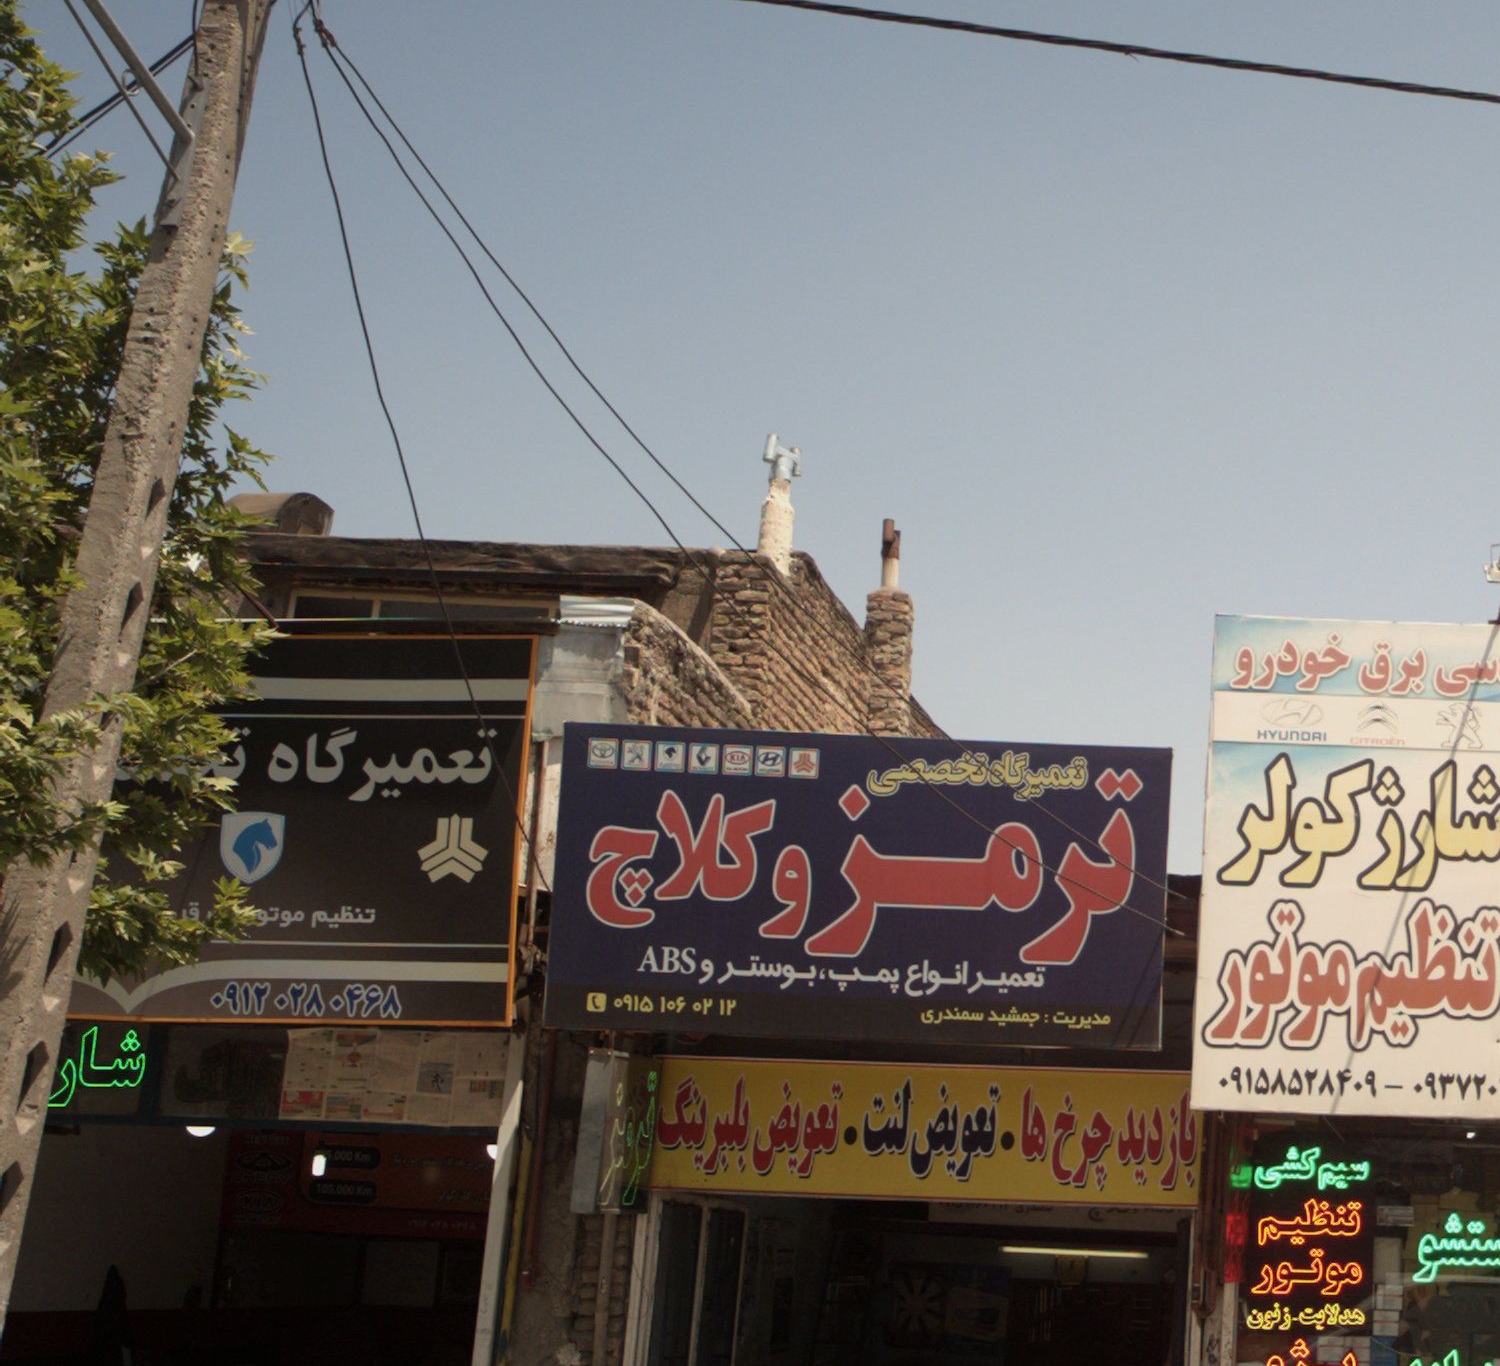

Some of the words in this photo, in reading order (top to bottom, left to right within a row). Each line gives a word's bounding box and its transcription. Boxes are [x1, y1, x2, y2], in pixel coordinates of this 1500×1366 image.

[1232, 633, 1351, 693] خودرو
[1359, 643, 1427, 694] برق
[729, 752, 747, 762] KIA
[1257, 729, 1328, 743] HYUNDAI
[866, 750, 990, 797] تخصصی
[1217, 752, 1376, 888] کولر
[586, 789, 777, 929] کلاچ
[803, 767, 1145, 965] ترمز
[758, 843, 813, 940] و
[254, 907, 304, 928] موتو
[312, 906, 376, 929] تنظیم
[637, 945, 696, 975] ABS
[698, 959, 713, 986] و
[718, 956, 818, 991] بوستر
[904, 960, 969, 998] انواع
[967, 965, 1046, 996] تعمیر
[1201, 897, 1357, 1050] موتور
[210, 980, 271, 1016] ۰۹۱۲
[613, 993, 655, 1013] ۰۹۱۵
[920, 1006, 985, 1025] سمندری
[987, 1006, 1041, 1028] جمشید
[1219, 1066, 1378, 1098] ۰۹۱۵۸۵۲۸۴۰۹
[660, 1076, 750, 1175] بلبرینگ
[752, 1080, 845, 1178] تعویض
[863, 1077, 912, 1157] لنت
[909, 1082, 1001, 1181] تعویض
[1020, 1085, 1048, 1162] ها
[1116, 1091, 1196, 1190] بازدید
[1052, 1092, 1115, 1192] چرخ
[1257, 1197, 1363, 1246] تنظیم
[1250, 1247, 1363, 1296] موتور
